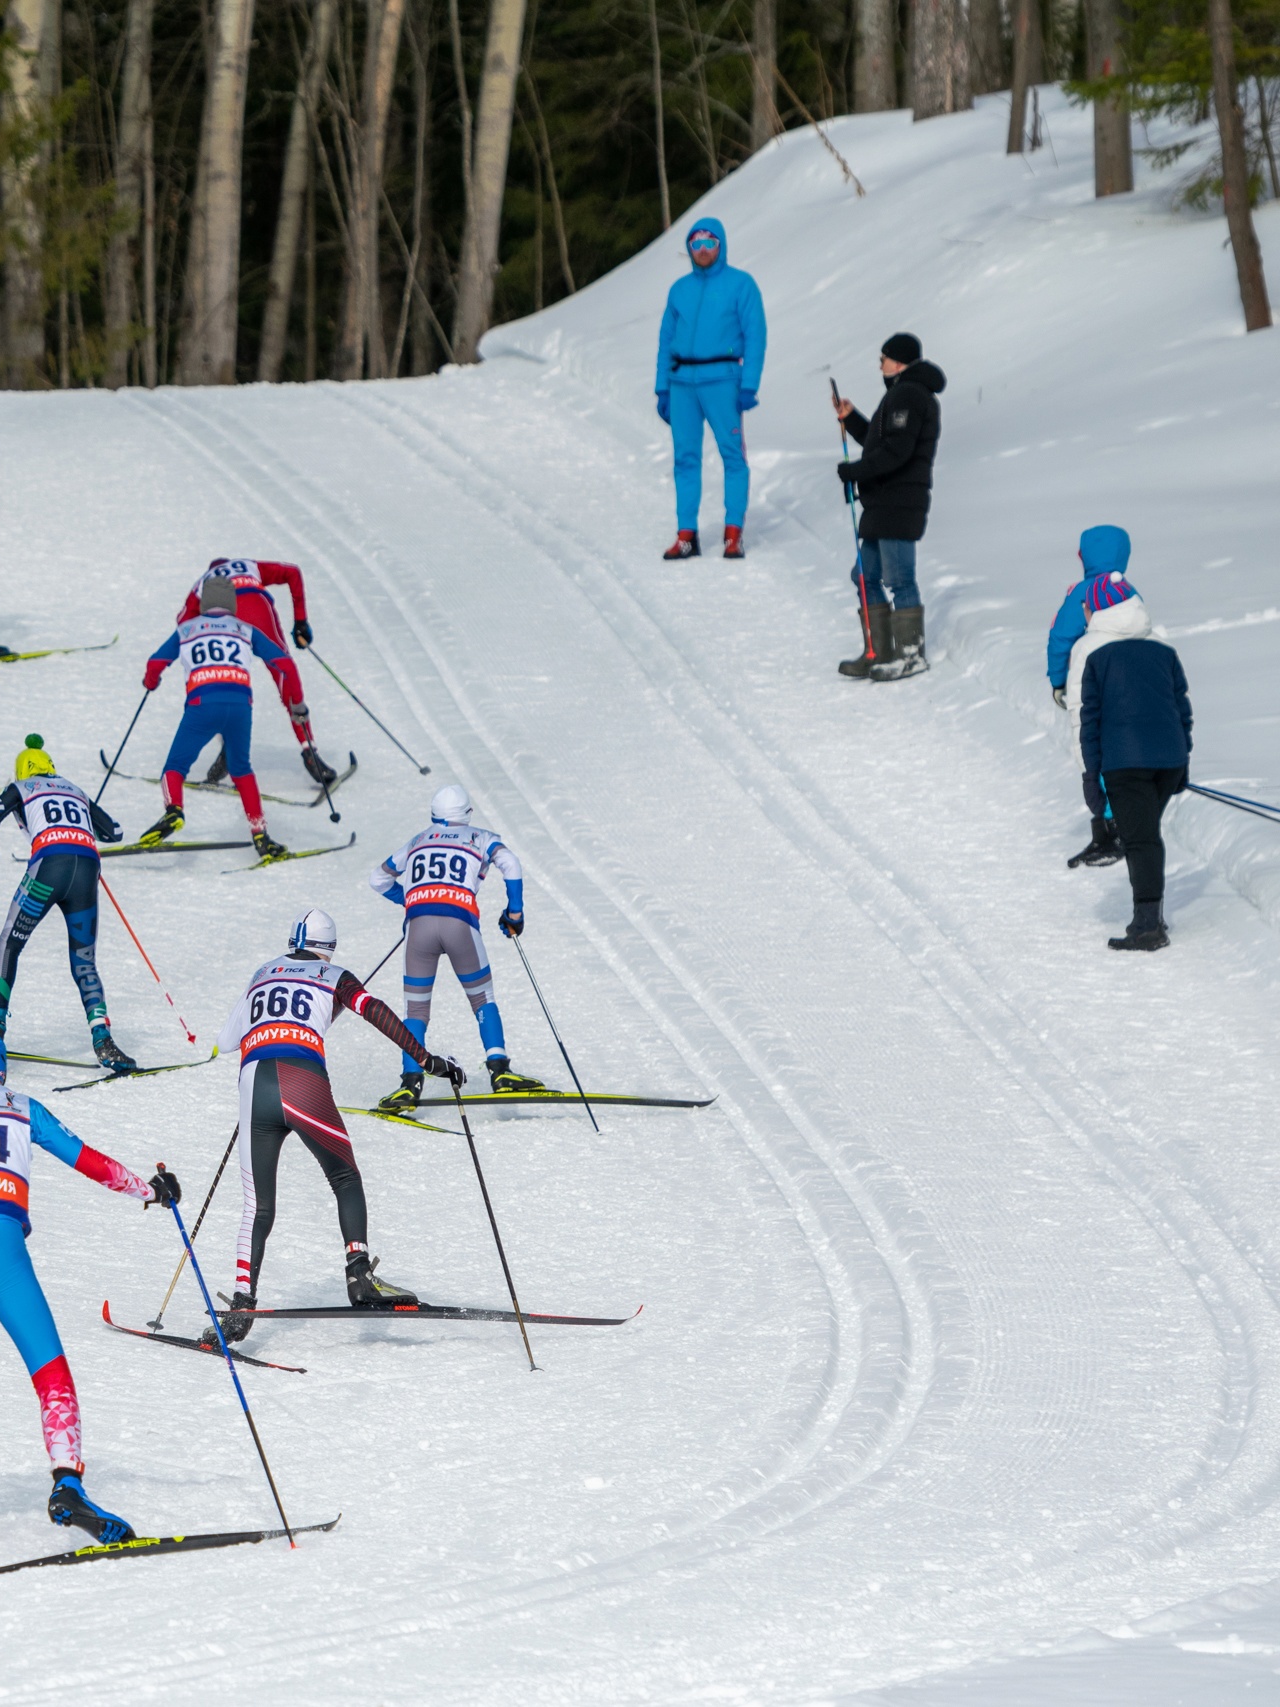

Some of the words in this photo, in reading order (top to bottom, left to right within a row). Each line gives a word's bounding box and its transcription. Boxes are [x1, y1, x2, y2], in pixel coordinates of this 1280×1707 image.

[191, 638, 243, 665] 662
[42, 799, 93, 832] 661
[411, 852, 468, 884] 659
[405, 888, 473, 906] УДМУРТИЯ
[249, 986, 314, 1025] 666
[244, 1028, 319, 1051] УДМУРТИЯ
[75, 1538, 161, 1558] FISCHER
